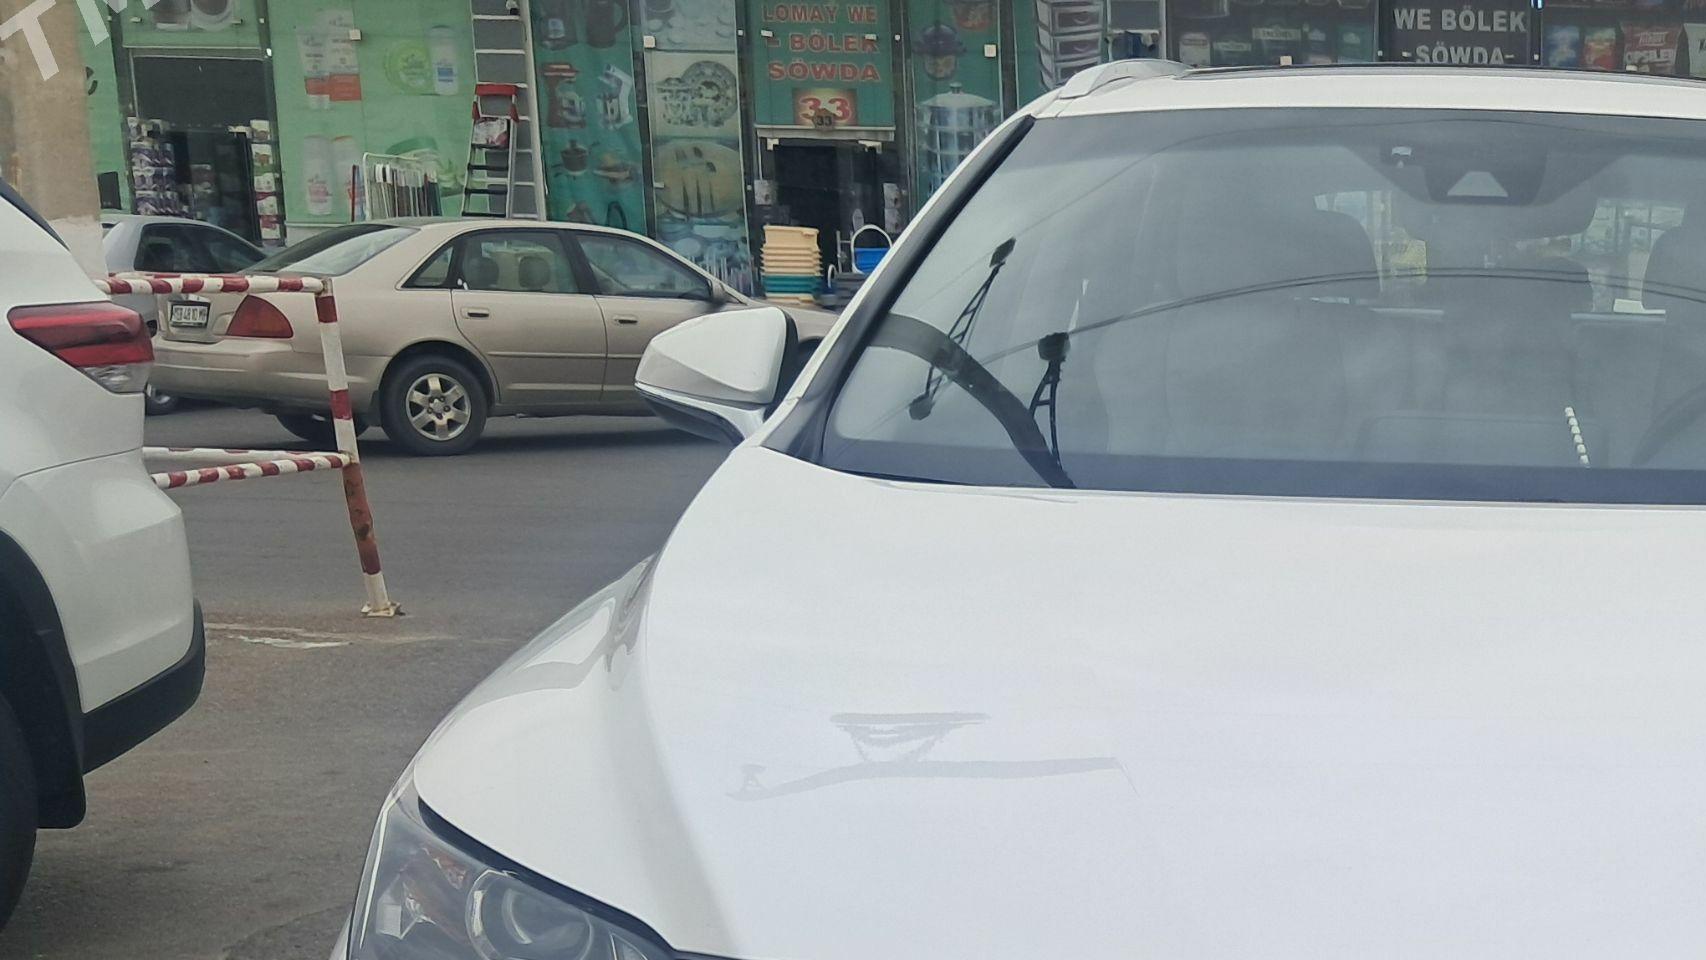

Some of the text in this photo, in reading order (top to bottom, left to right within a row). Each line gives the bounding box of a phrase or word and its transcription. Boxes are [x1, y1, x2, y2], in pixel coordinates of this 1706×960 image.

[846, 5, 878, 23] WE
[1393, 5, 1528, 33] WE BÖLEK
[1415, 40, 1505, 65] SÖWDA
[767, 58, 881, 82] SÖWDA
[799, 96, 852, 121] 33
